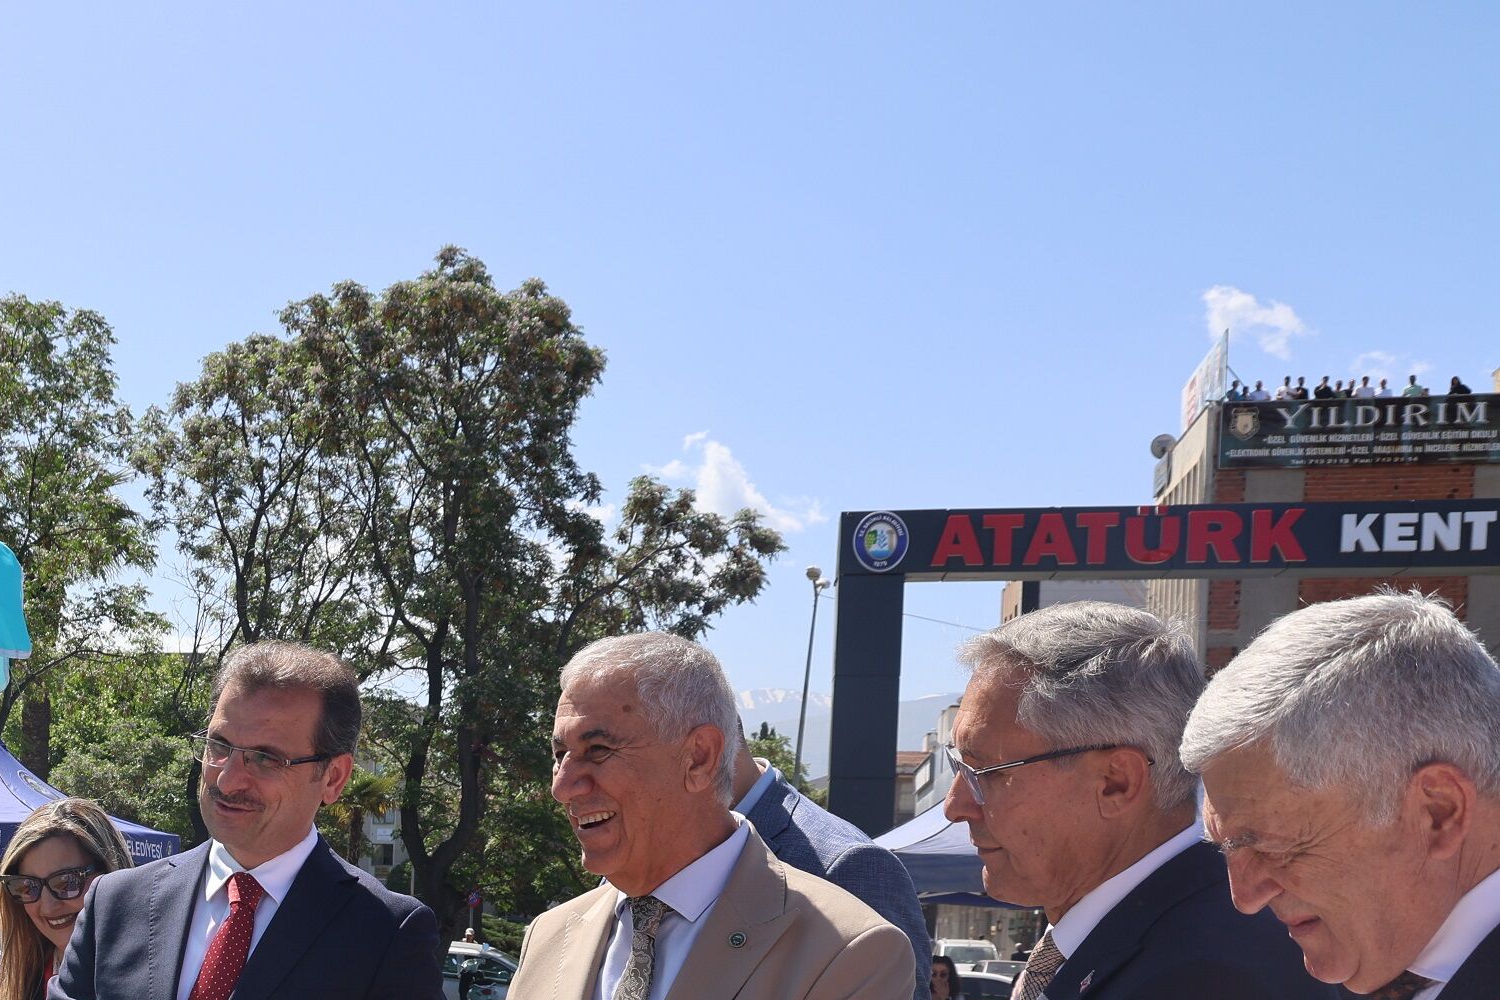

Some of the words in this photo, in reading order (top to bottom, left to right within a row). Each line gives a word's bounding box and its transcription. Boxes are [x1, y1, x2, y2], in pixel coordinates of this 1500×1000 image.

[1276, 402, 1490, 429] YILDIRIM
[930, 505, 1307, 567] ATATÜRK
[1340, 510, 1498, 553] KENT
